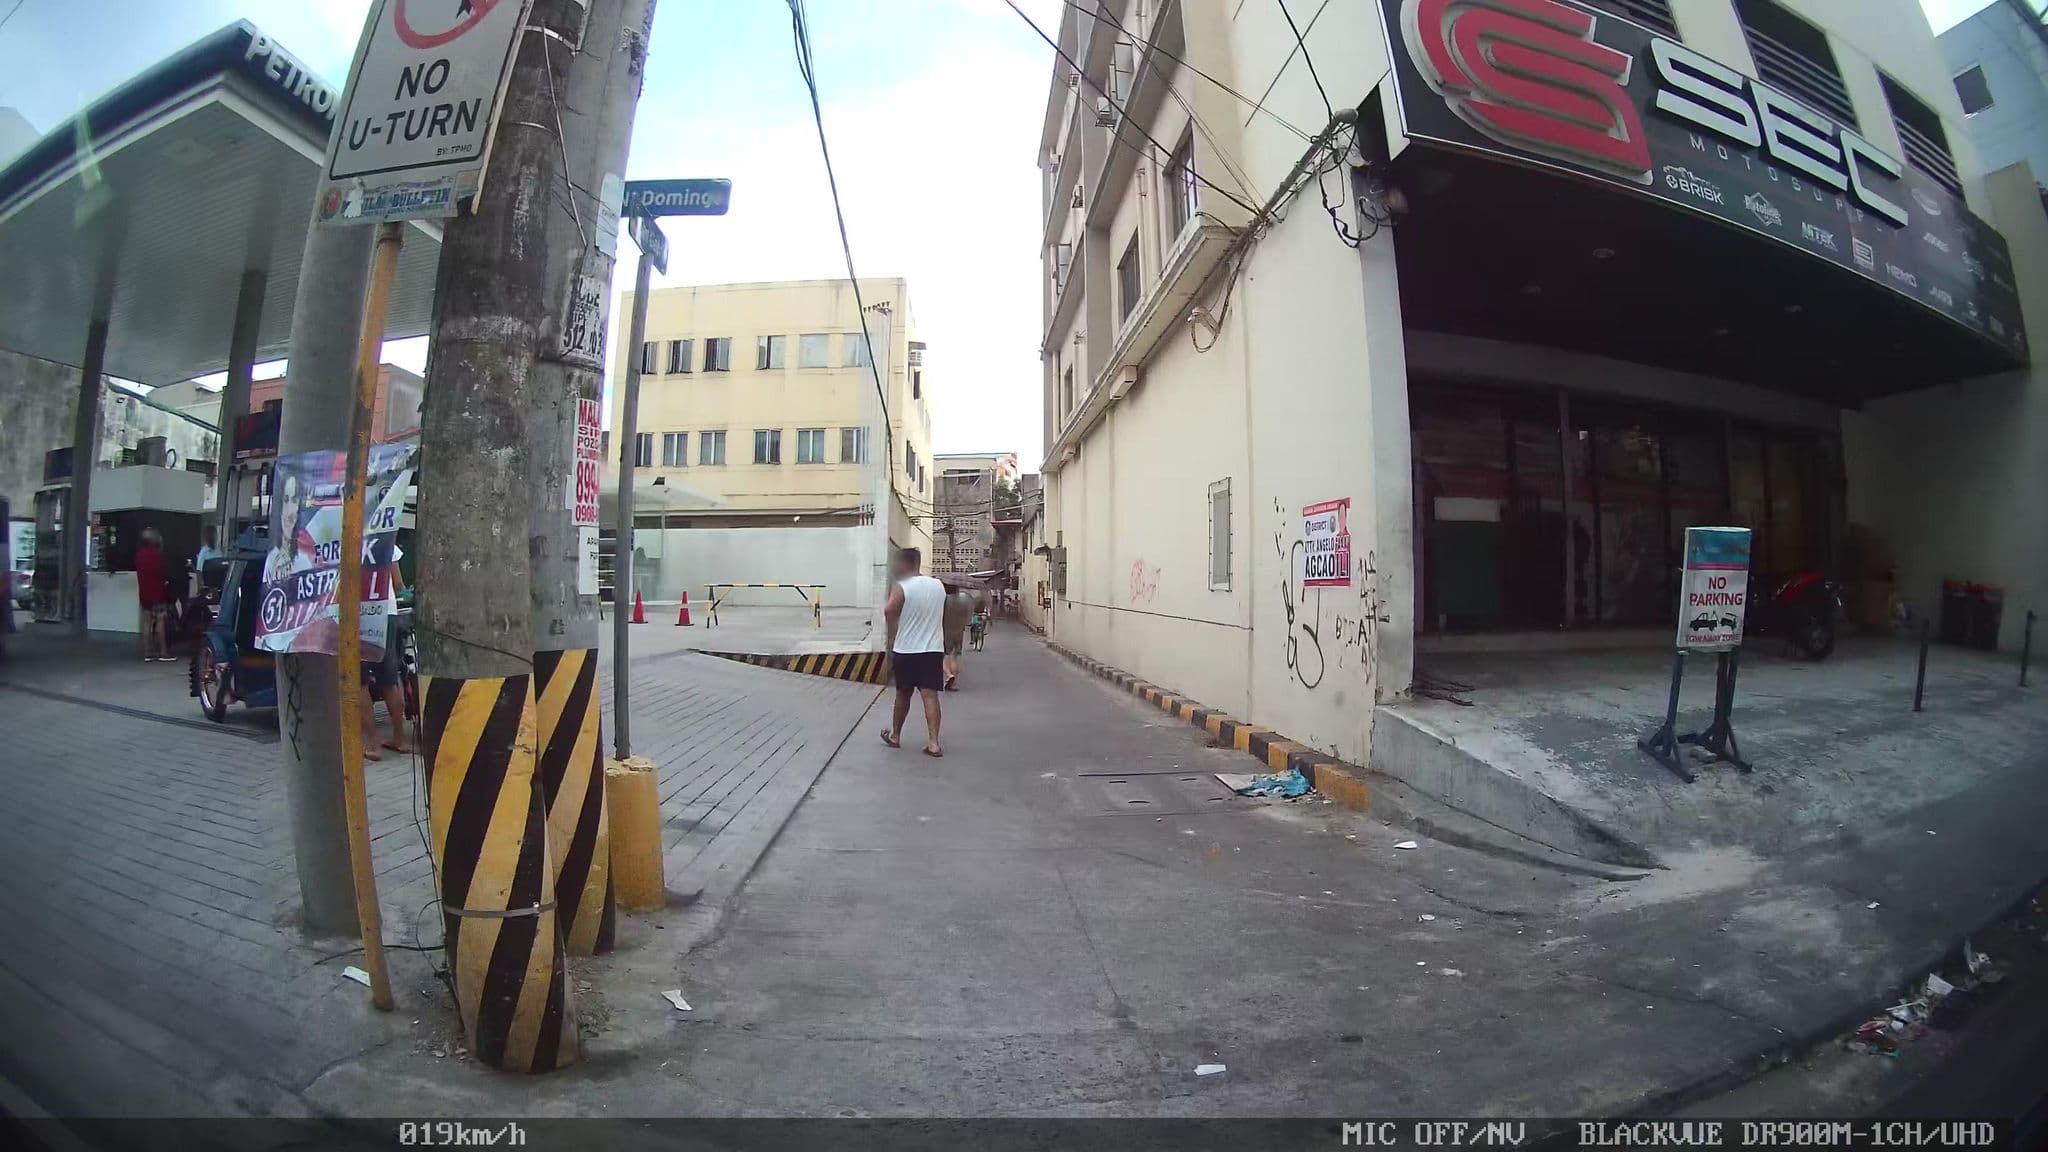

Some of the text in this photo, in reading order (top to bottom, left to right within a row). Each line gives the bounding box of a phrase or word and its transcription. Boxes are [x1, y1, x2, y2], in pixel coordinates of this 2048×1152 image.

[395, 59, 450, 100] NO
[349, 98, 481, 151] U-TURN
[1651, 37, 1908, 227] SEC
[1680, 178, 1724, 206] BRISK
[1689, 132, 1898, 234] MOTOSUPP
[1689, 593, 1743, 607] PARKING
[1708, 577, 1727, 590] NO
[266, 596, 283, 625] 51
